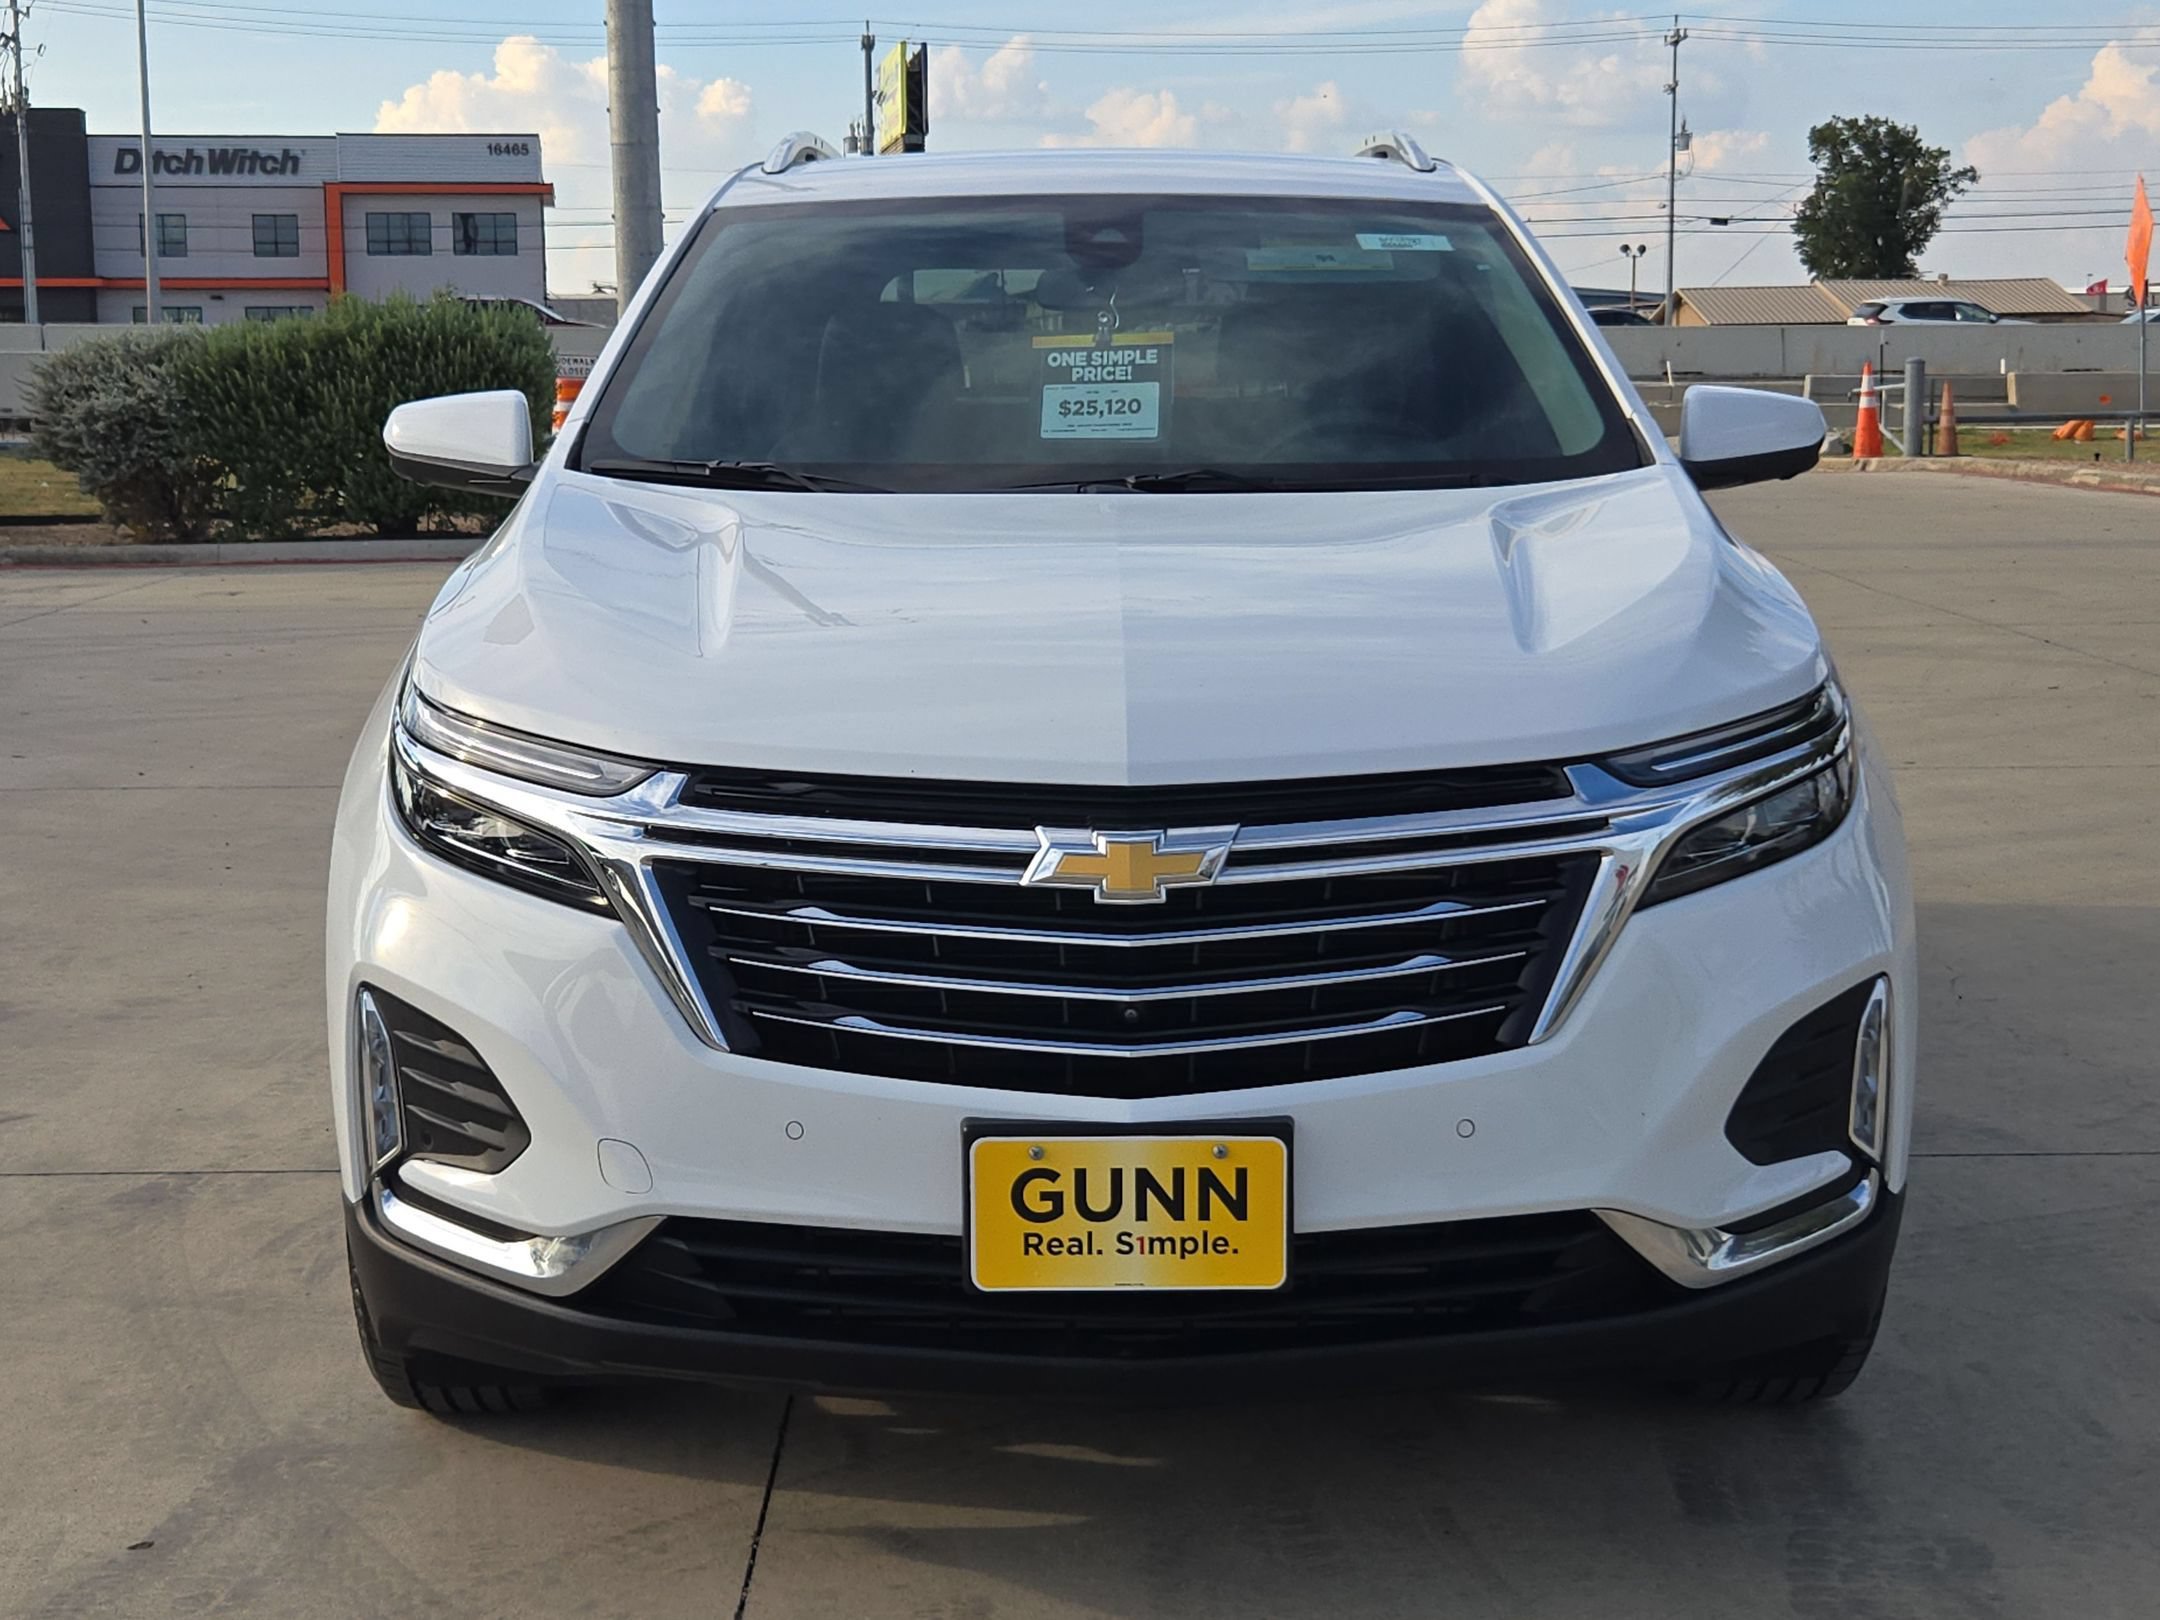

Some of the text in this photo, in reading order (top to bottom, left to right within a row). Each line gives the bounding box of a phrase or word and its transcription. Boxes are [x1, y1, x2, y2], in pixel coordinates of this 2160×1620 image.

[487, 142, 529, 157] 16465
[113, 148, 301, 175] Dtch Witch
[1047, 349, 1158, 367] ONE SIMPLE
[1071, 366, 1132, 382] PRICE!
[1058, 398, 1142, 419] $25,120
[1010, 1167, 1248, 1223] GUNN
[1023, 1231, 1103, 1256] Real.
